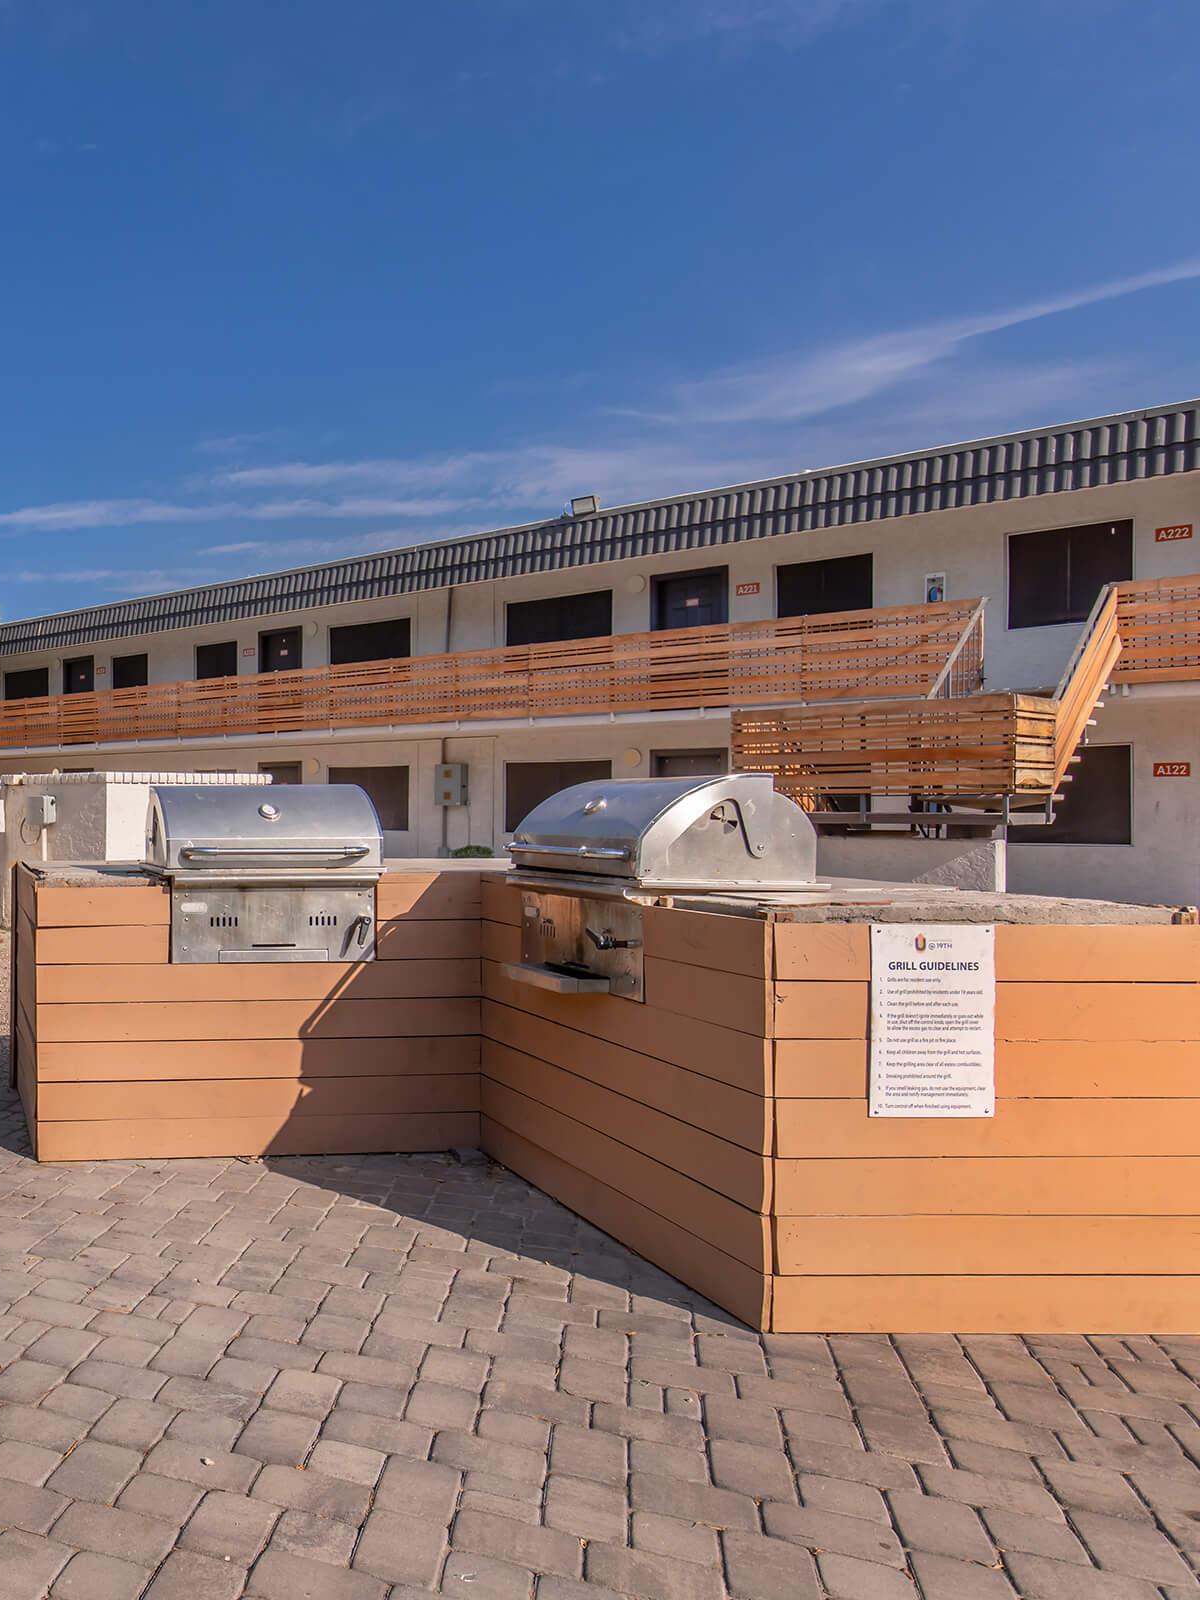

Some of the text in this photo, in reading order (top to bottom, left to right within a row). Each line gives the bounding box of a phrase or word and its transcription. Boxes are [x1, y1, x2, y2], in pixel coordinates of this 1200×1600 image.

[1158, 527, 1189, 540] A222
[737, 585, 757, 594] A221
[1156, 765, 1187, 775] A122
[888, 961, 980, 971] GRILL GUIDELINES
